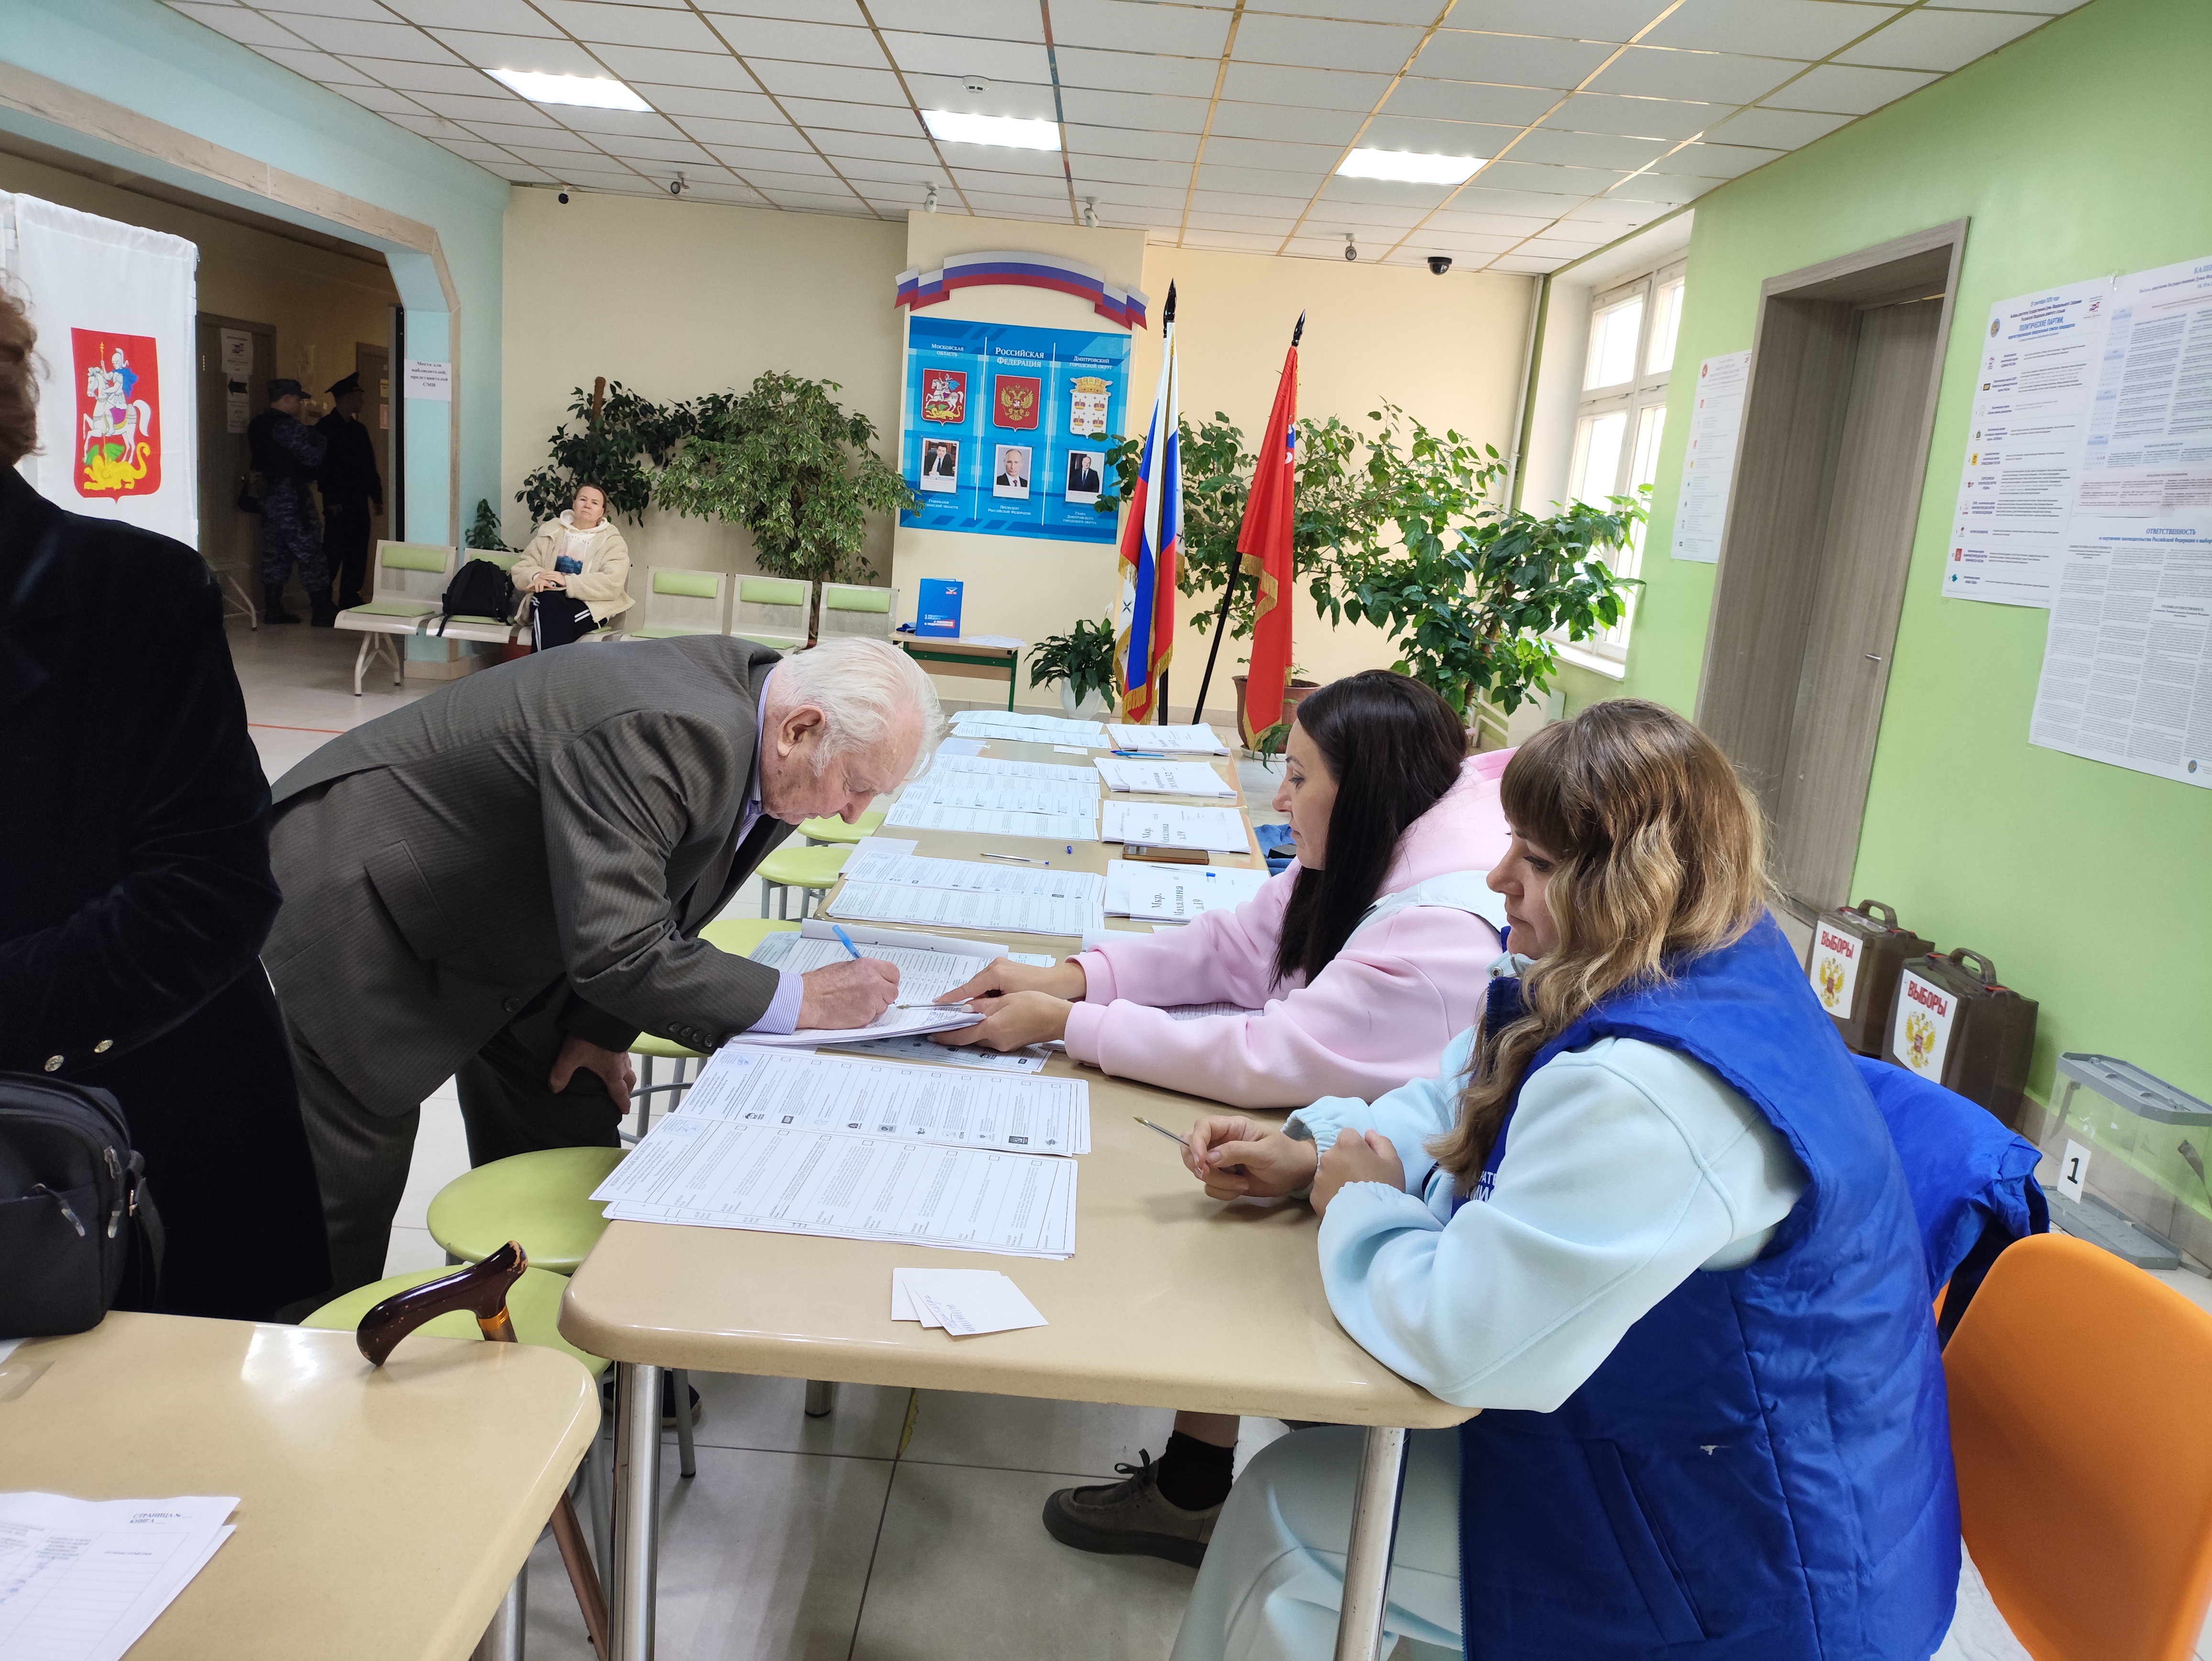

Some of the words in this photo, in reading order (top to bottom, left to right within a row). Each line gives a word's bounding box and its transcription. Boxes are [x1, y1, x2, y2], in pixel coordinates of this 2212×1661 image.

[1142, 827, 1154, 839] Мкр.
[1176, 831, 1186, 841] д.19
[1151, 893, 1165, 909] Мкр.
[1174, 886, 1184, 916] Махалина
[1193, 899, 1205, 910] д.19
[1821, 930, 1855, 959] ВЫБОРЫ
[1907, 980, 1948, 1018] ВЫБОРЫ
[2067, 1157, 2079, 1185] 1
